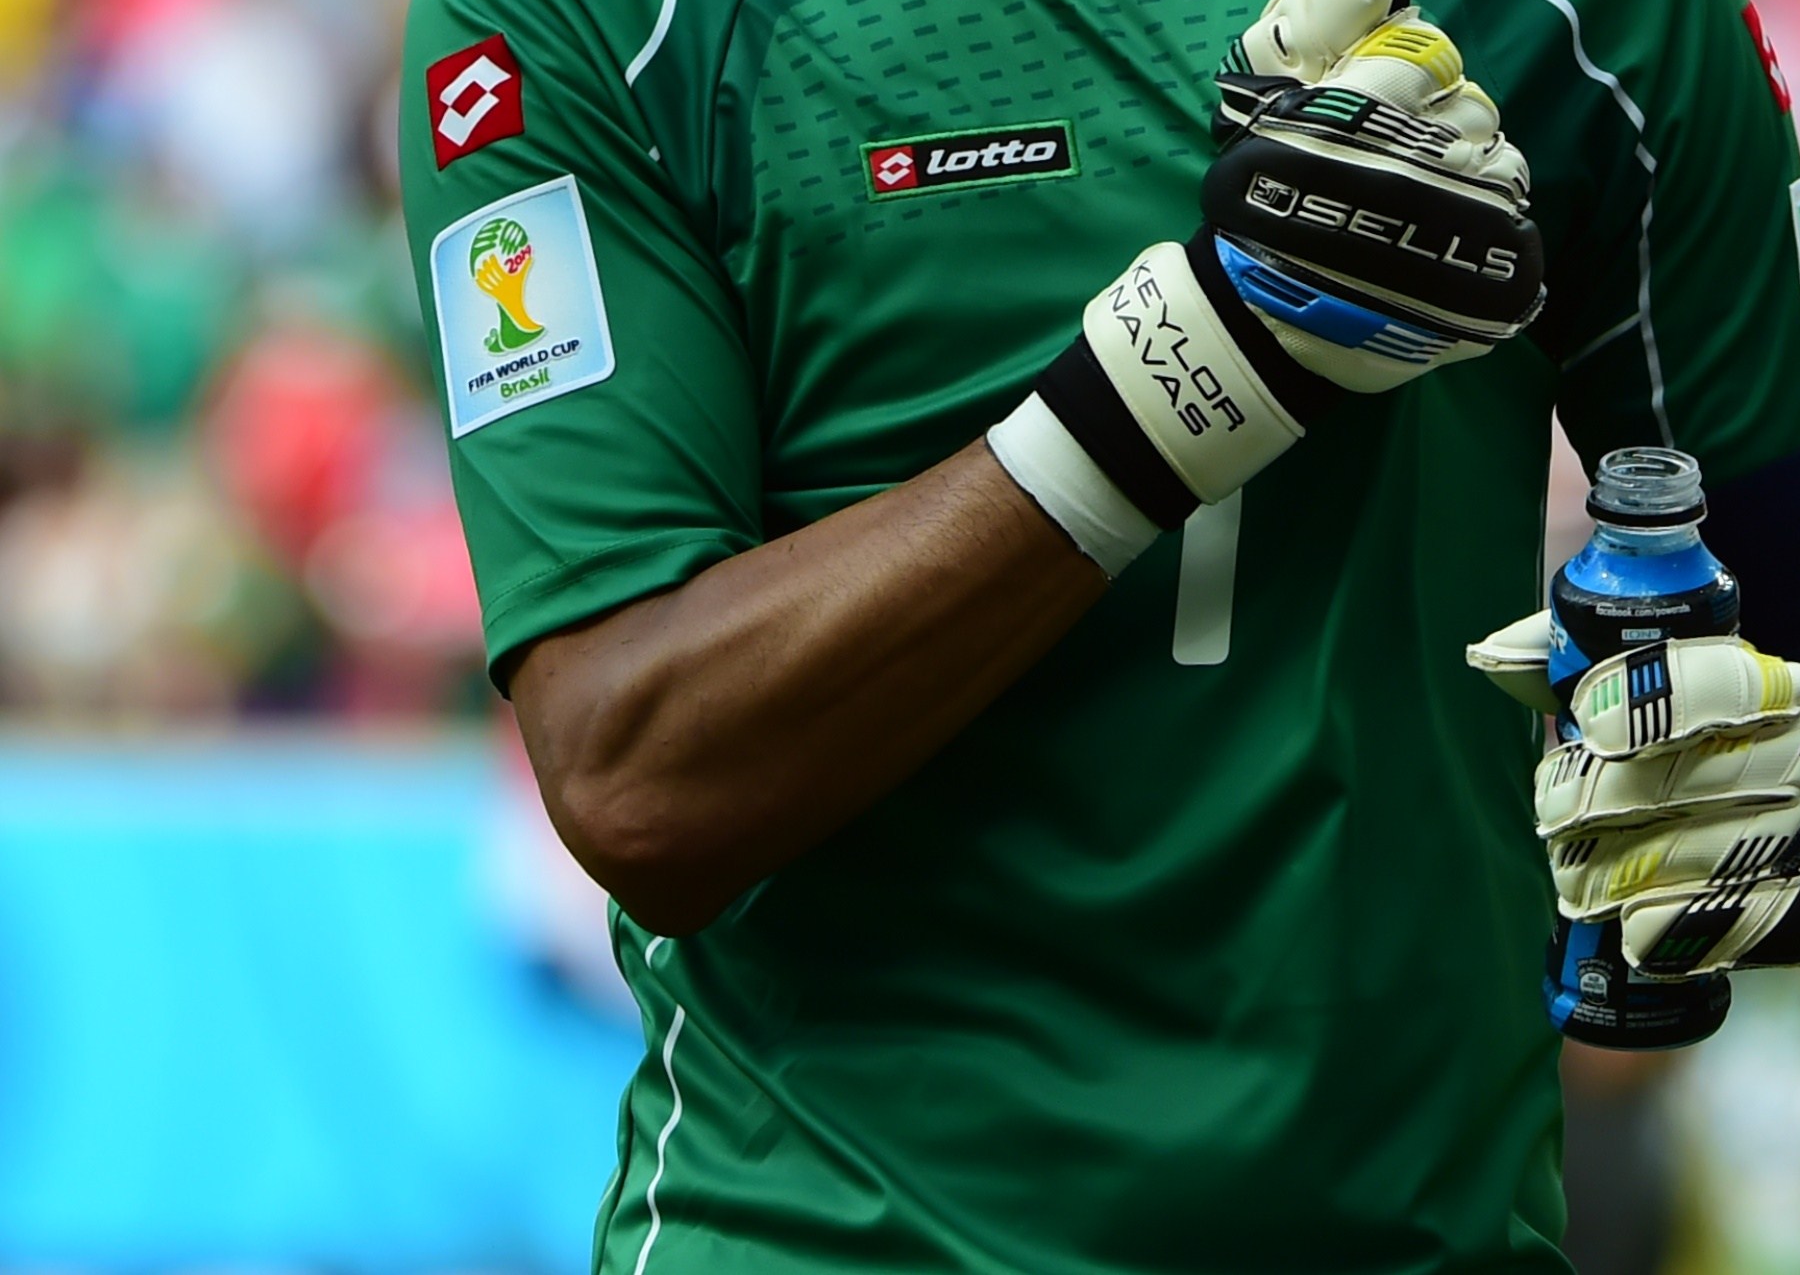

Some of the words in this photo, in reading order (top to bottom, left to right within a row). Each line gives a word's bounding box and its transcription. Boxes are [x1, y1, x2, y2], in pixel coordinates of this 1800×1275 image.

[926, 140, 1057, 174] lotto
[504, 244, 532, 274] 2014
[1297, 195, 1518, 280] SELLS
[468, 371, 495, 393] FIFA
[495, 349, 549, 379] WORLD
[551, 339, 580, 357] CUP
[1108, 284, 1212, 437] NAVAS
[1132, 259, 1246, 432] KEYLOR
[500, 367, 550, 398] Brasil
